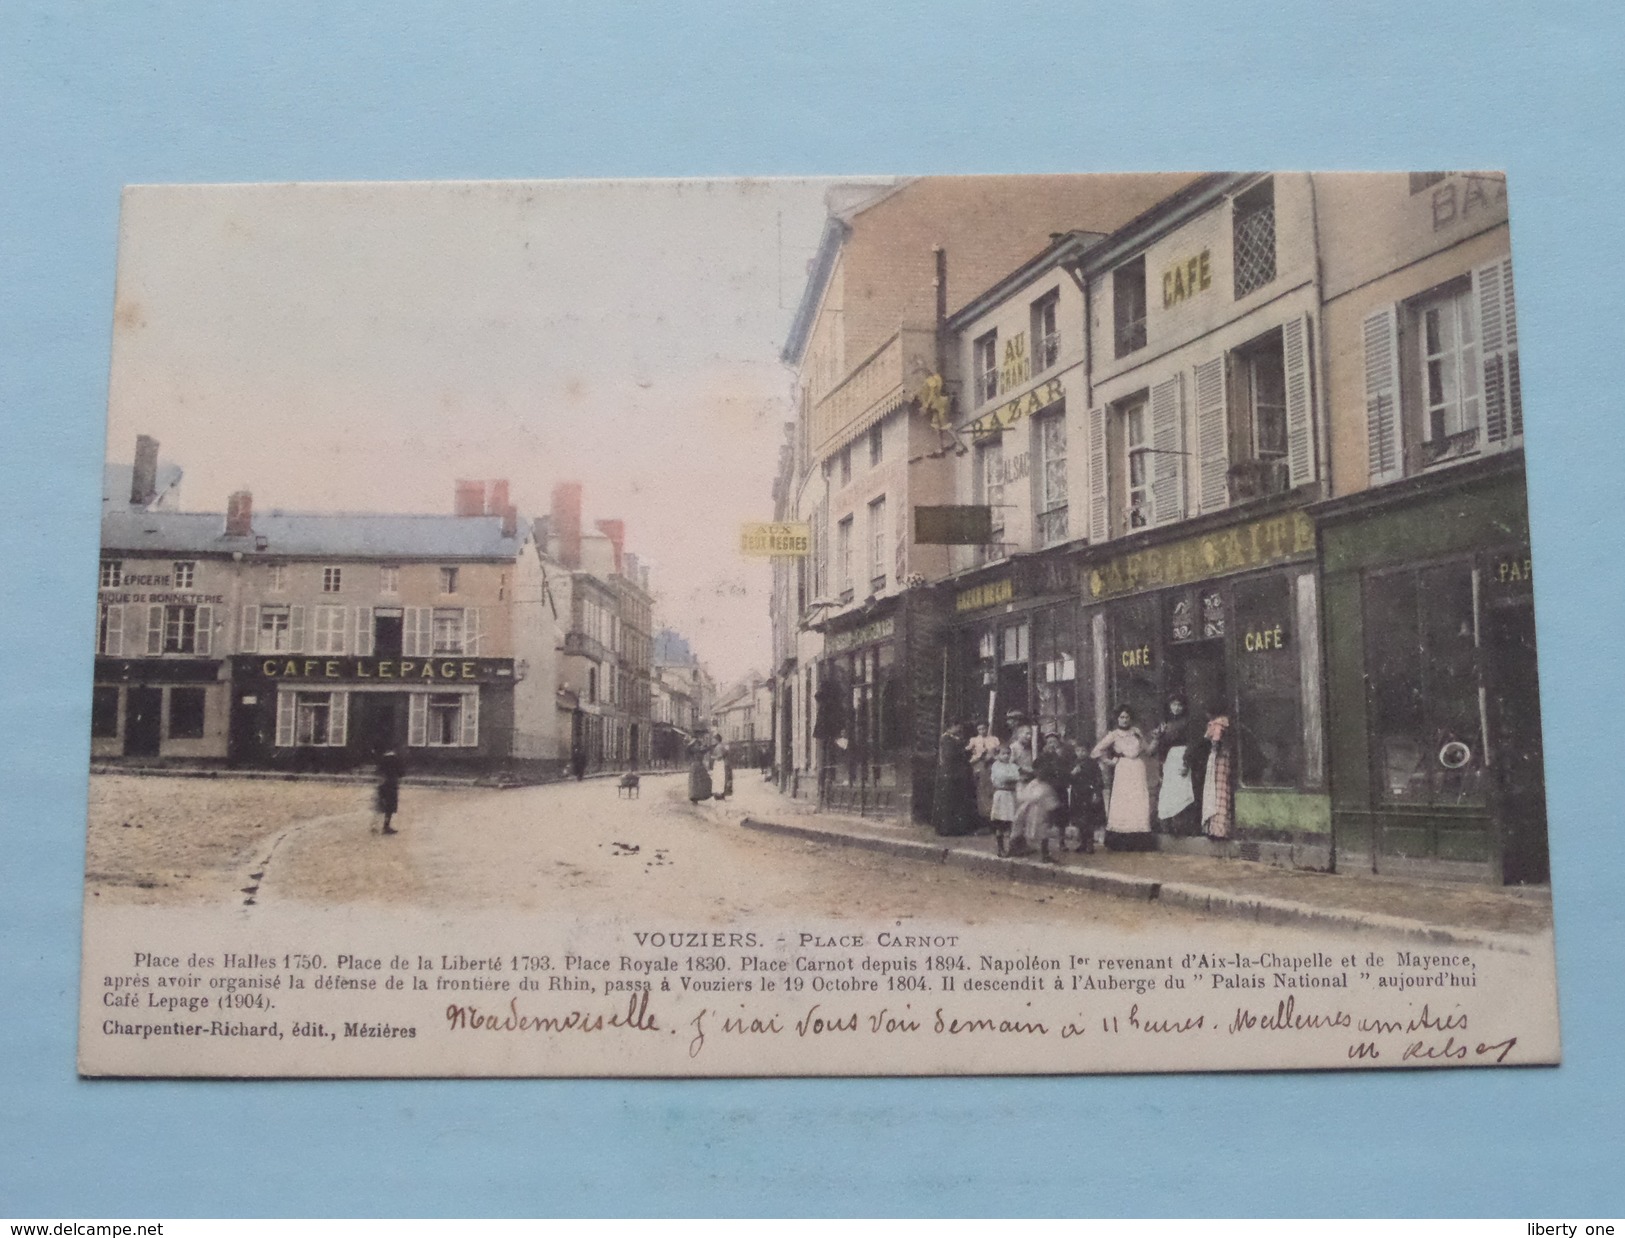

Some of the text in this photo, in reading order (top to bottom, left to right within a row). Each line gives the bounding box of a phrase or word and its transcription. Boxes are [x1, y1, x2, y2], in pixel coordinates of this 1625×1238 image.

[1004, 330, 1025, 366] AU
[972, 377, 1067, 445] BAZAR
[757, 526, 791, 535] AUX
[123, 575, 171, 586] EPICERIE
[133, 593, 145, 603] DE
[149, 594, 223, 604] BONNETERIE
[1245, 624, 1283, 651] CAFÉ
[1122, 644, 1150, 667] CAFÉ
[632, 931, 764, 948] VOUZIERS.
[798, 932, 864, 948] PLACE
[877, 932, 959, 948] CARNOT
[133, 951, 180, 968] Place
[187, 952, 215, 969] des
[223, 953, 277, 969] Halles
[282, 953, 327, 970] 1750.
[337, 954, 382, 970] Place
[389, 954, 410, 971] de
[417, 955, 434, 971] la
[441, 954, 503, 972] Liberté
[510, 955, 556, 971] 1793.
[564, 954, 611, 971] Place
[619, 955, 680, 978] Royale
[685, 955, 731, 972] 1830.
[740, 956, 790, 972] Place
[795, 956, 855, 972] Carnot
[861, 955, 918, 977] depuis
[924, 955, 971, 972] 1894.
[979, 954, 1061, 978] Napoléon
[1097, 956, 1173, 970] revenant
[1181, 952, 1333, 976] d'Aix-la-Chapelle
[1340, 954, 1357, 968] et
[1365, 951, 1385, 969] de
[1396, 951, 1476, 974] Mayence,
[103, 973, 150, 994] après
[157, 972, 202, 988] avoir
[208, 974, 281, 994] organisé
[288, 974, 306, 990] la
[314, 974, 377, 991] défense
[384, 974, 404, 991] de
[412, 975, 429, 991] la
[436, 975, 511, 992] frontière
[518, 976, 540, 992] du
[548, 975, 596, 995] Rhin,
[604, 977, 653, 994] passa
[660, 976, 671, 992] à
[679, 976, 753, 992] Vouziers
[760, 976, 776, 992] le
[783, 976, 804, 992] 19
[811, 975, 879, 992] Octobre
[886, 975, 932, 992] 1804.
[941, 975, 956, 992] Il
[963, 975, 1045, 992] descendit
[1053, 975, 1065, 991] à
[1071, 974, 1156, 995] l'Auberge
[1164, 974, 1186, 990] du
[1211, 973, 1266, 990] Palais
[1272, 971, 1348, 990] National
[1378, 971, 1477, 992] aujourd'hui
[102, 992, 276, 1013] Café Lepage (1904).
[933, 1001, 1049, 1035] demain
[102, 1019, 417, 1042] Charpentier-Richard, édit., Mézières
